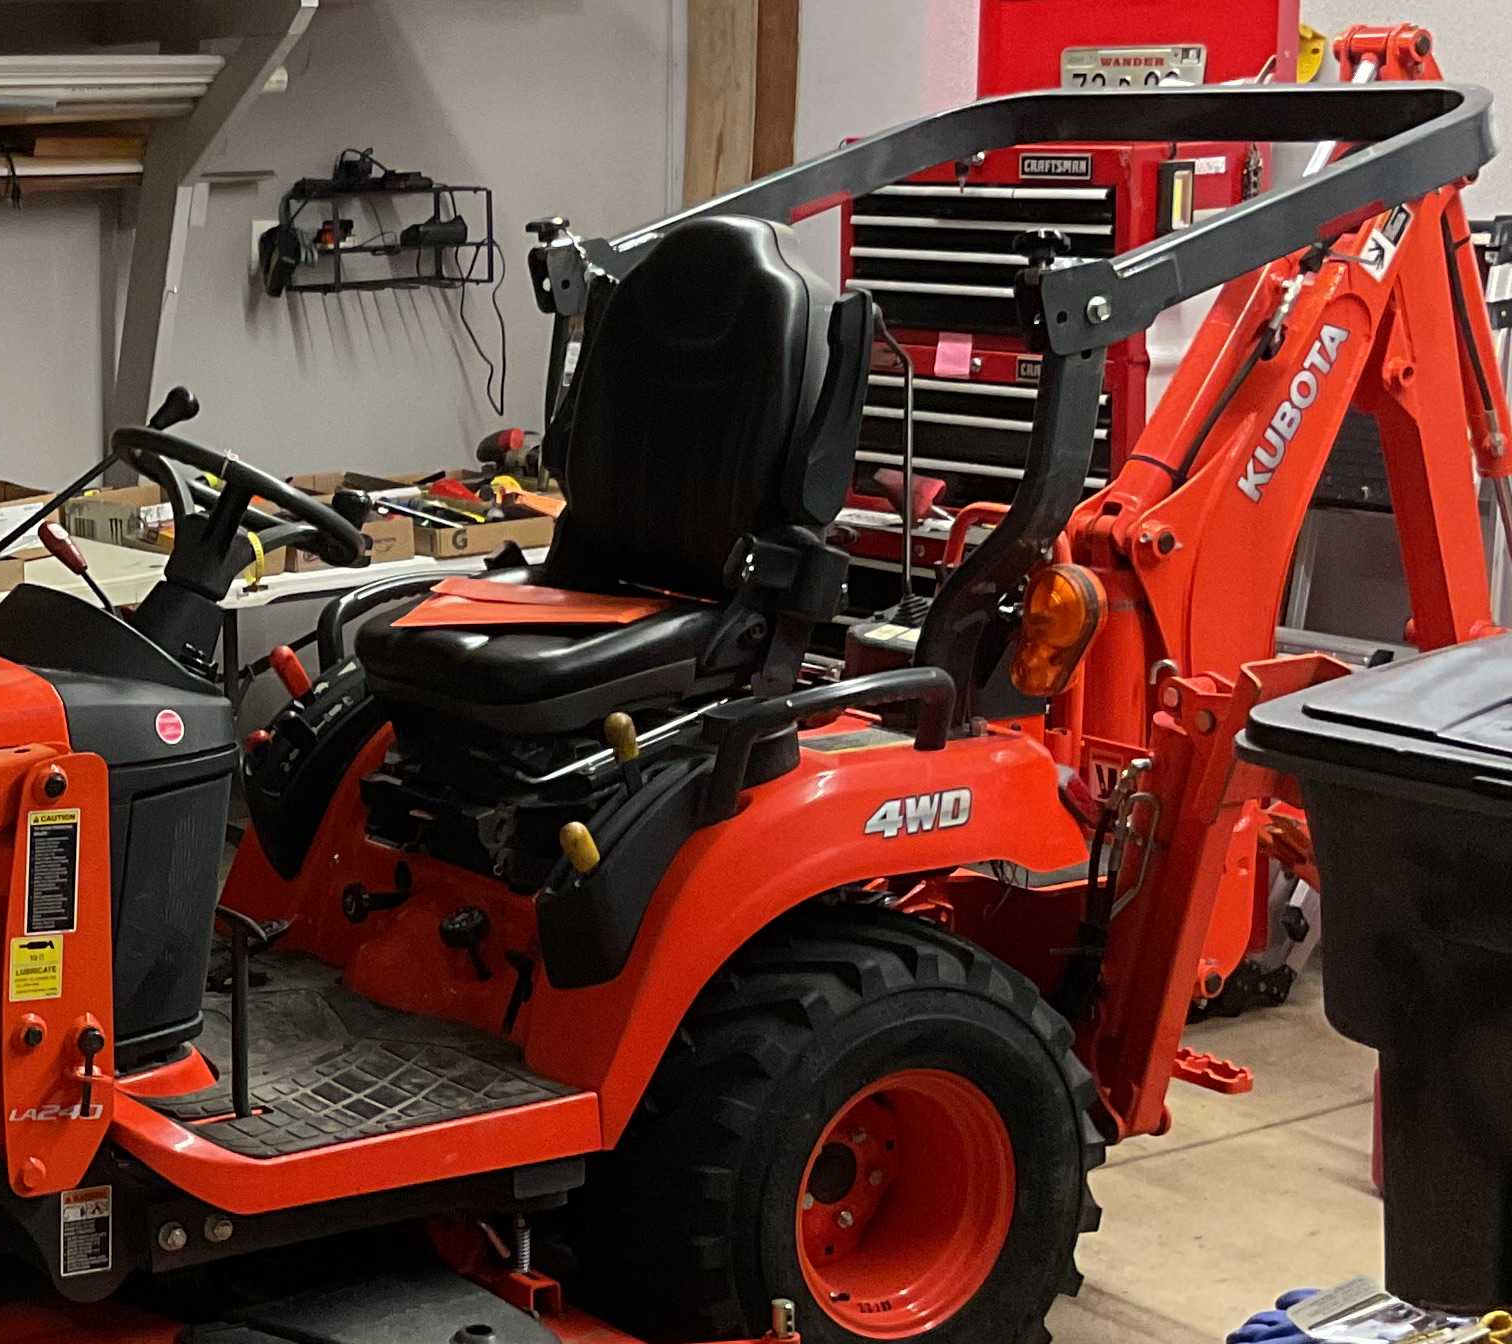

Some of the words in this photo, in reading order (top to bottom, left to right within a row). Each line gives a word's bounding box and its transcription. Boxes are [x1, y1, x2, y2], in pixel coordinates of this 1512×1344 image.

[1100, 57, 1165, 67] WANDER
[1023, 159, 1087, 173] CRAFTSMAN
[1237, 323, 1351, 504] KUBOTA
[41, 813, 76, 823] CAUTION
[864, 786, 972, 839] 4WD
[15, 965, 57, 976] LUBRICATE
[8, 1104, 104, 1122] LA240
